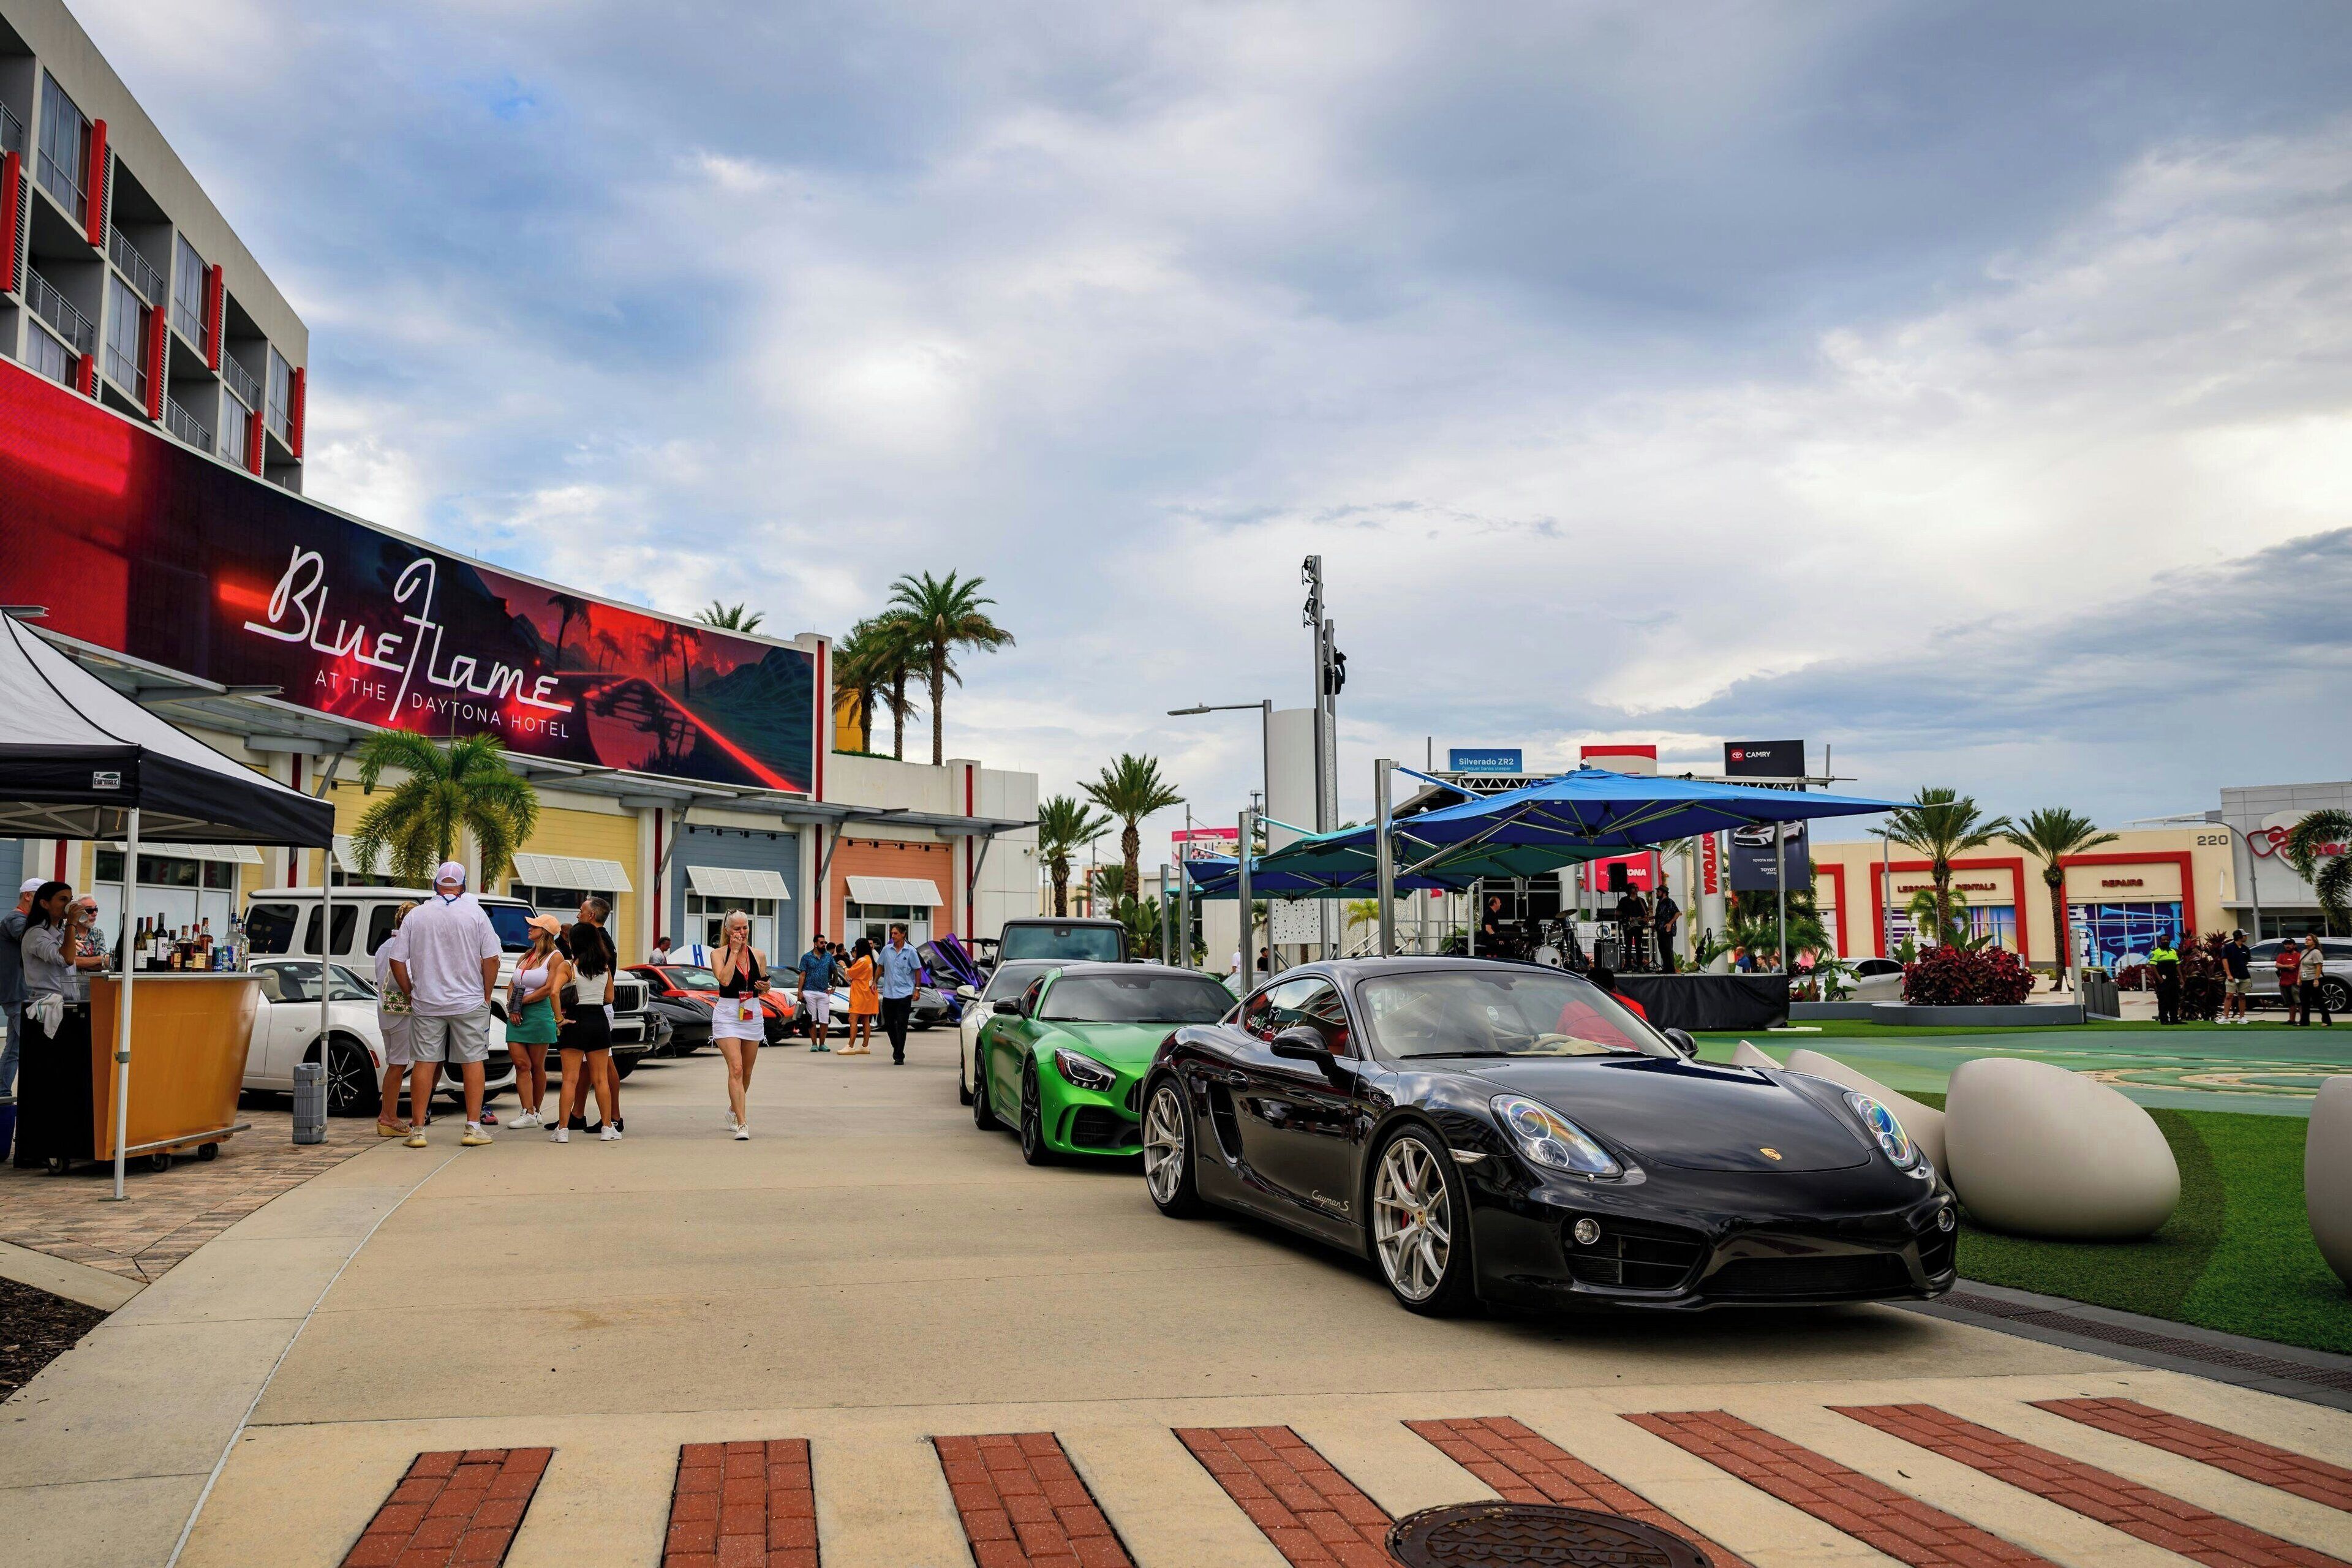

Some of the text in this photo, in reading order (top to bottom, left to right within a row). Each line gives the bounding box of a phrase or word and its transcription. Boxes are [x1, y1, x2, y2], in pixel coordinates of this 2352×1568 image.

[315, 669, 569, 738] AT THE DAYTONA HOTEL
[2196, 834, 2229, 846] 220
[1702, 832, 1717, 895] AYTONA
[1955, 883, 1997, 891] RENTALS
[2101, 878, 2144, 888] REPAIRS
[1312, 1189, 1349, 1212] Cayman S
[1429, 1540, 1668, 1566] ONE DAYTONA
